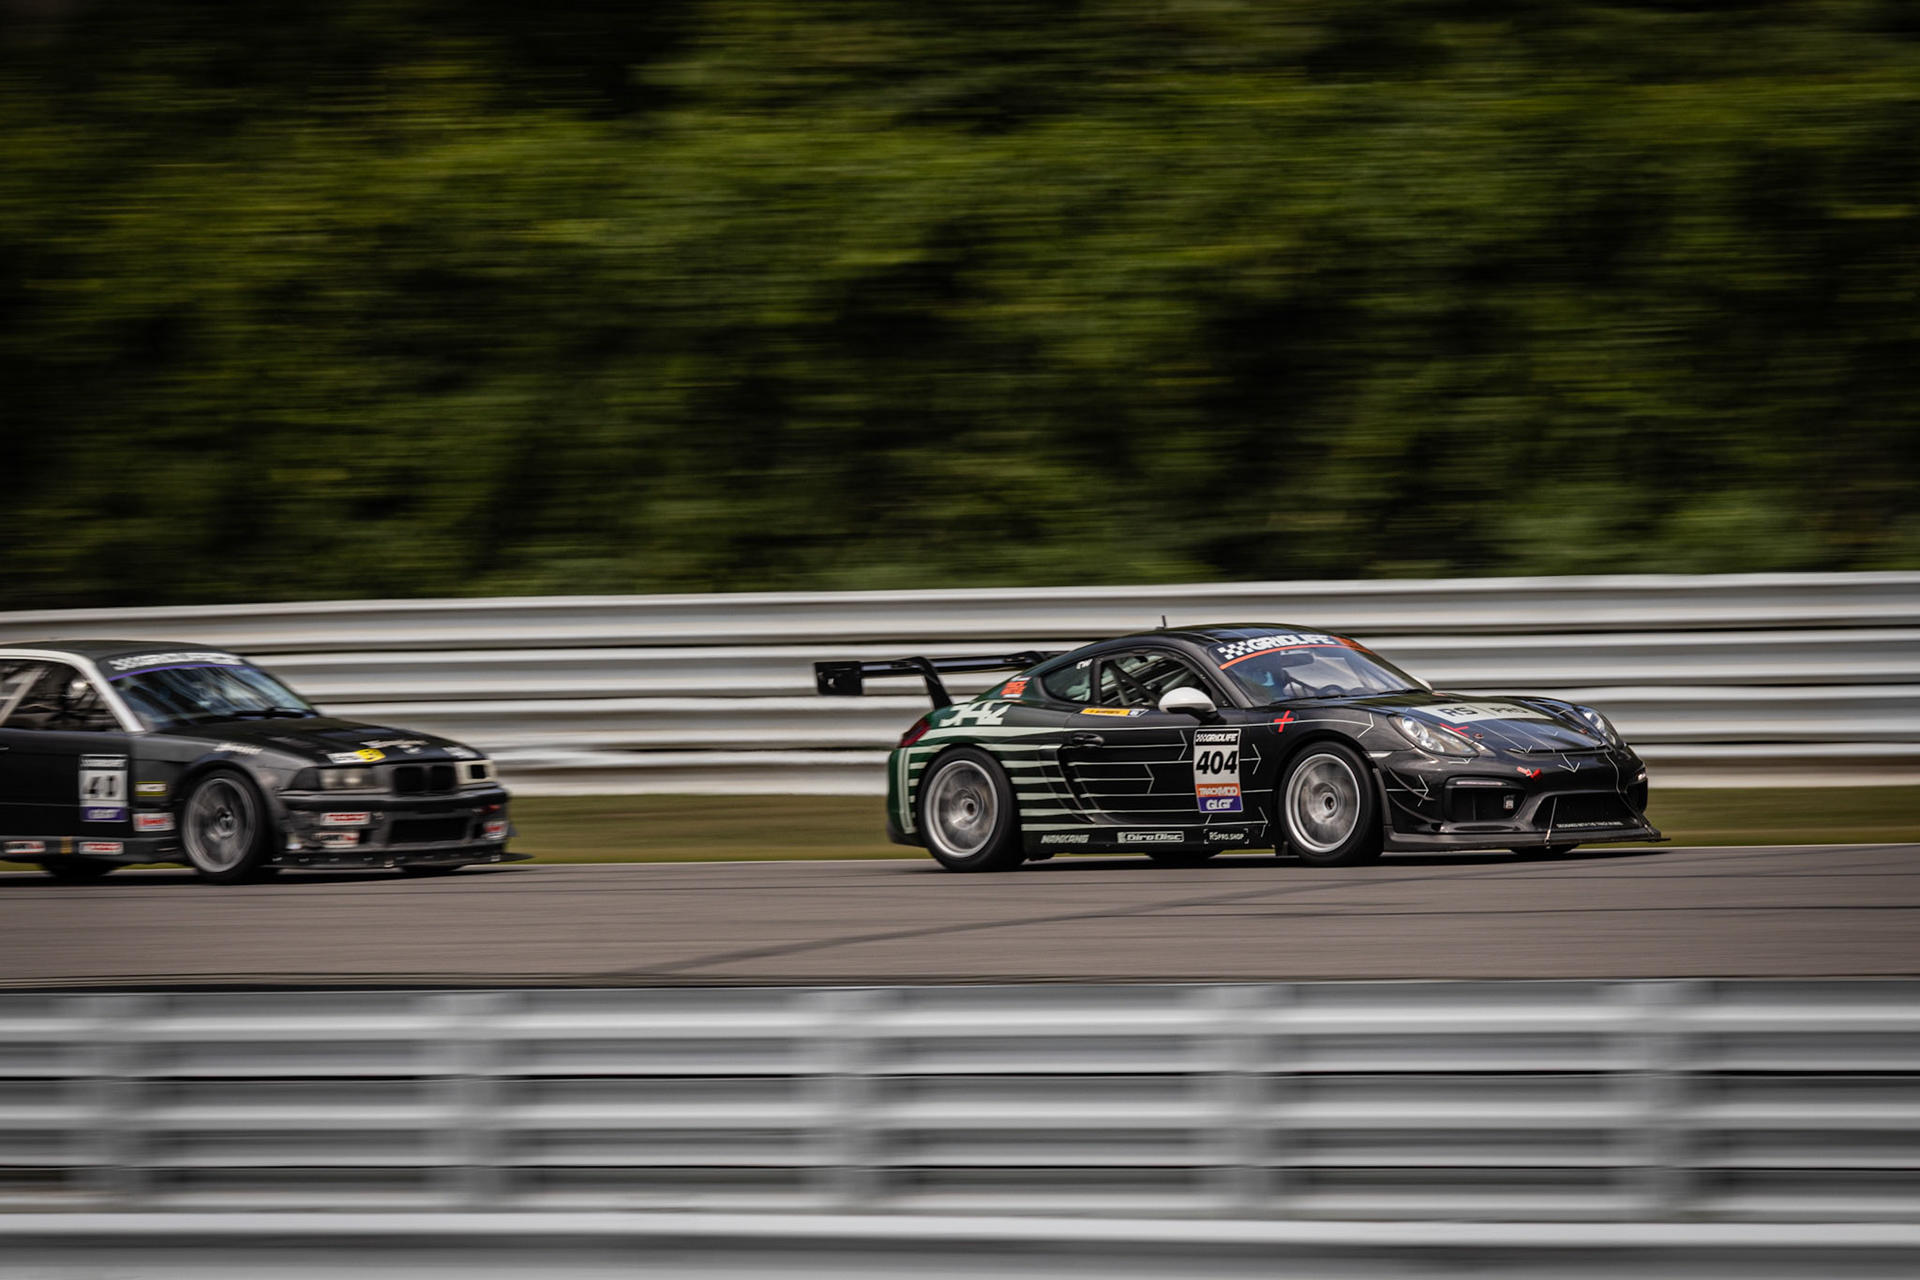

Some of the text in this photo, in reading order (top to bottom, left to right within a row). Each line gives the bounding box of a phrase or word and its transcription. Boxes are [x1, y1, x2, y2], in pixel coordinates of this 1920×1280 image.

[1247, 634, 1336, 650] GRIDLIFE
[1437, 707, 1478, 717] RS
[1206, 733, 1238, 742] GRIDLIFE
[1196, 750, 1238, 774] 404
